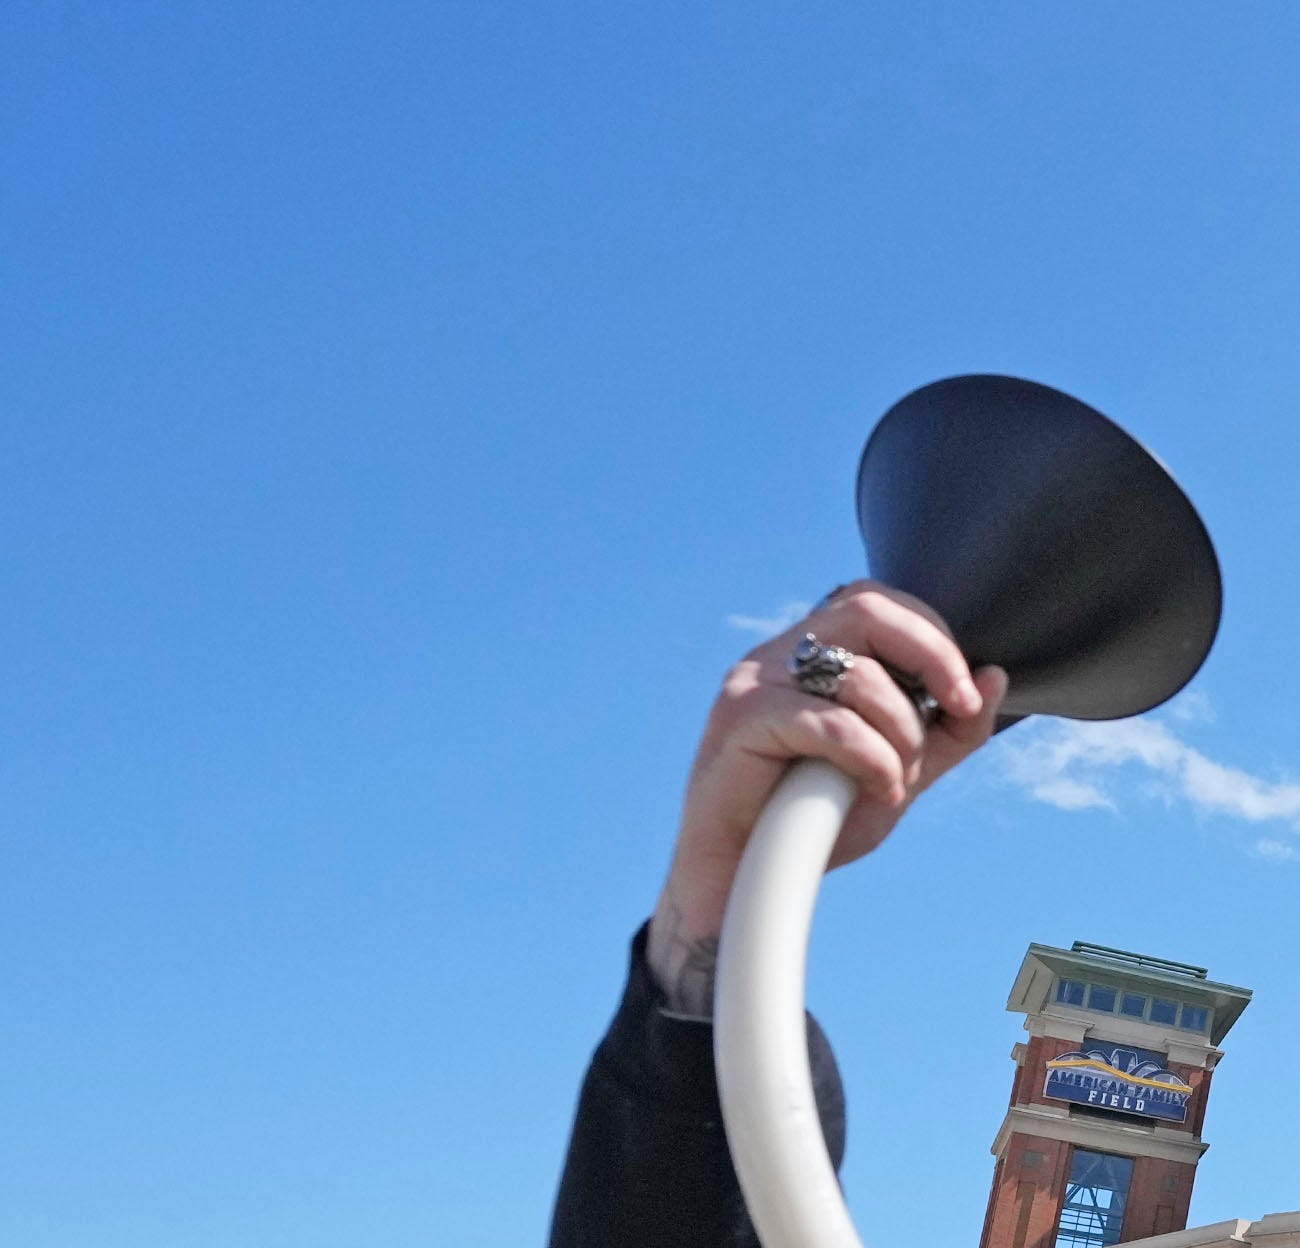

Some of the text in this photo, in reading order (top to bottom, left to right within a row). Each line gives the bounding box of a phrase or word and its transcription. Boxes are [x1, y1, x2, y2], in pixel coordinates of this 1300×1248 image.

[1050, 1070, 1189, 1105] AMERICAN FAMILY
[1088, 1090, 1145, 1111] FIELD
